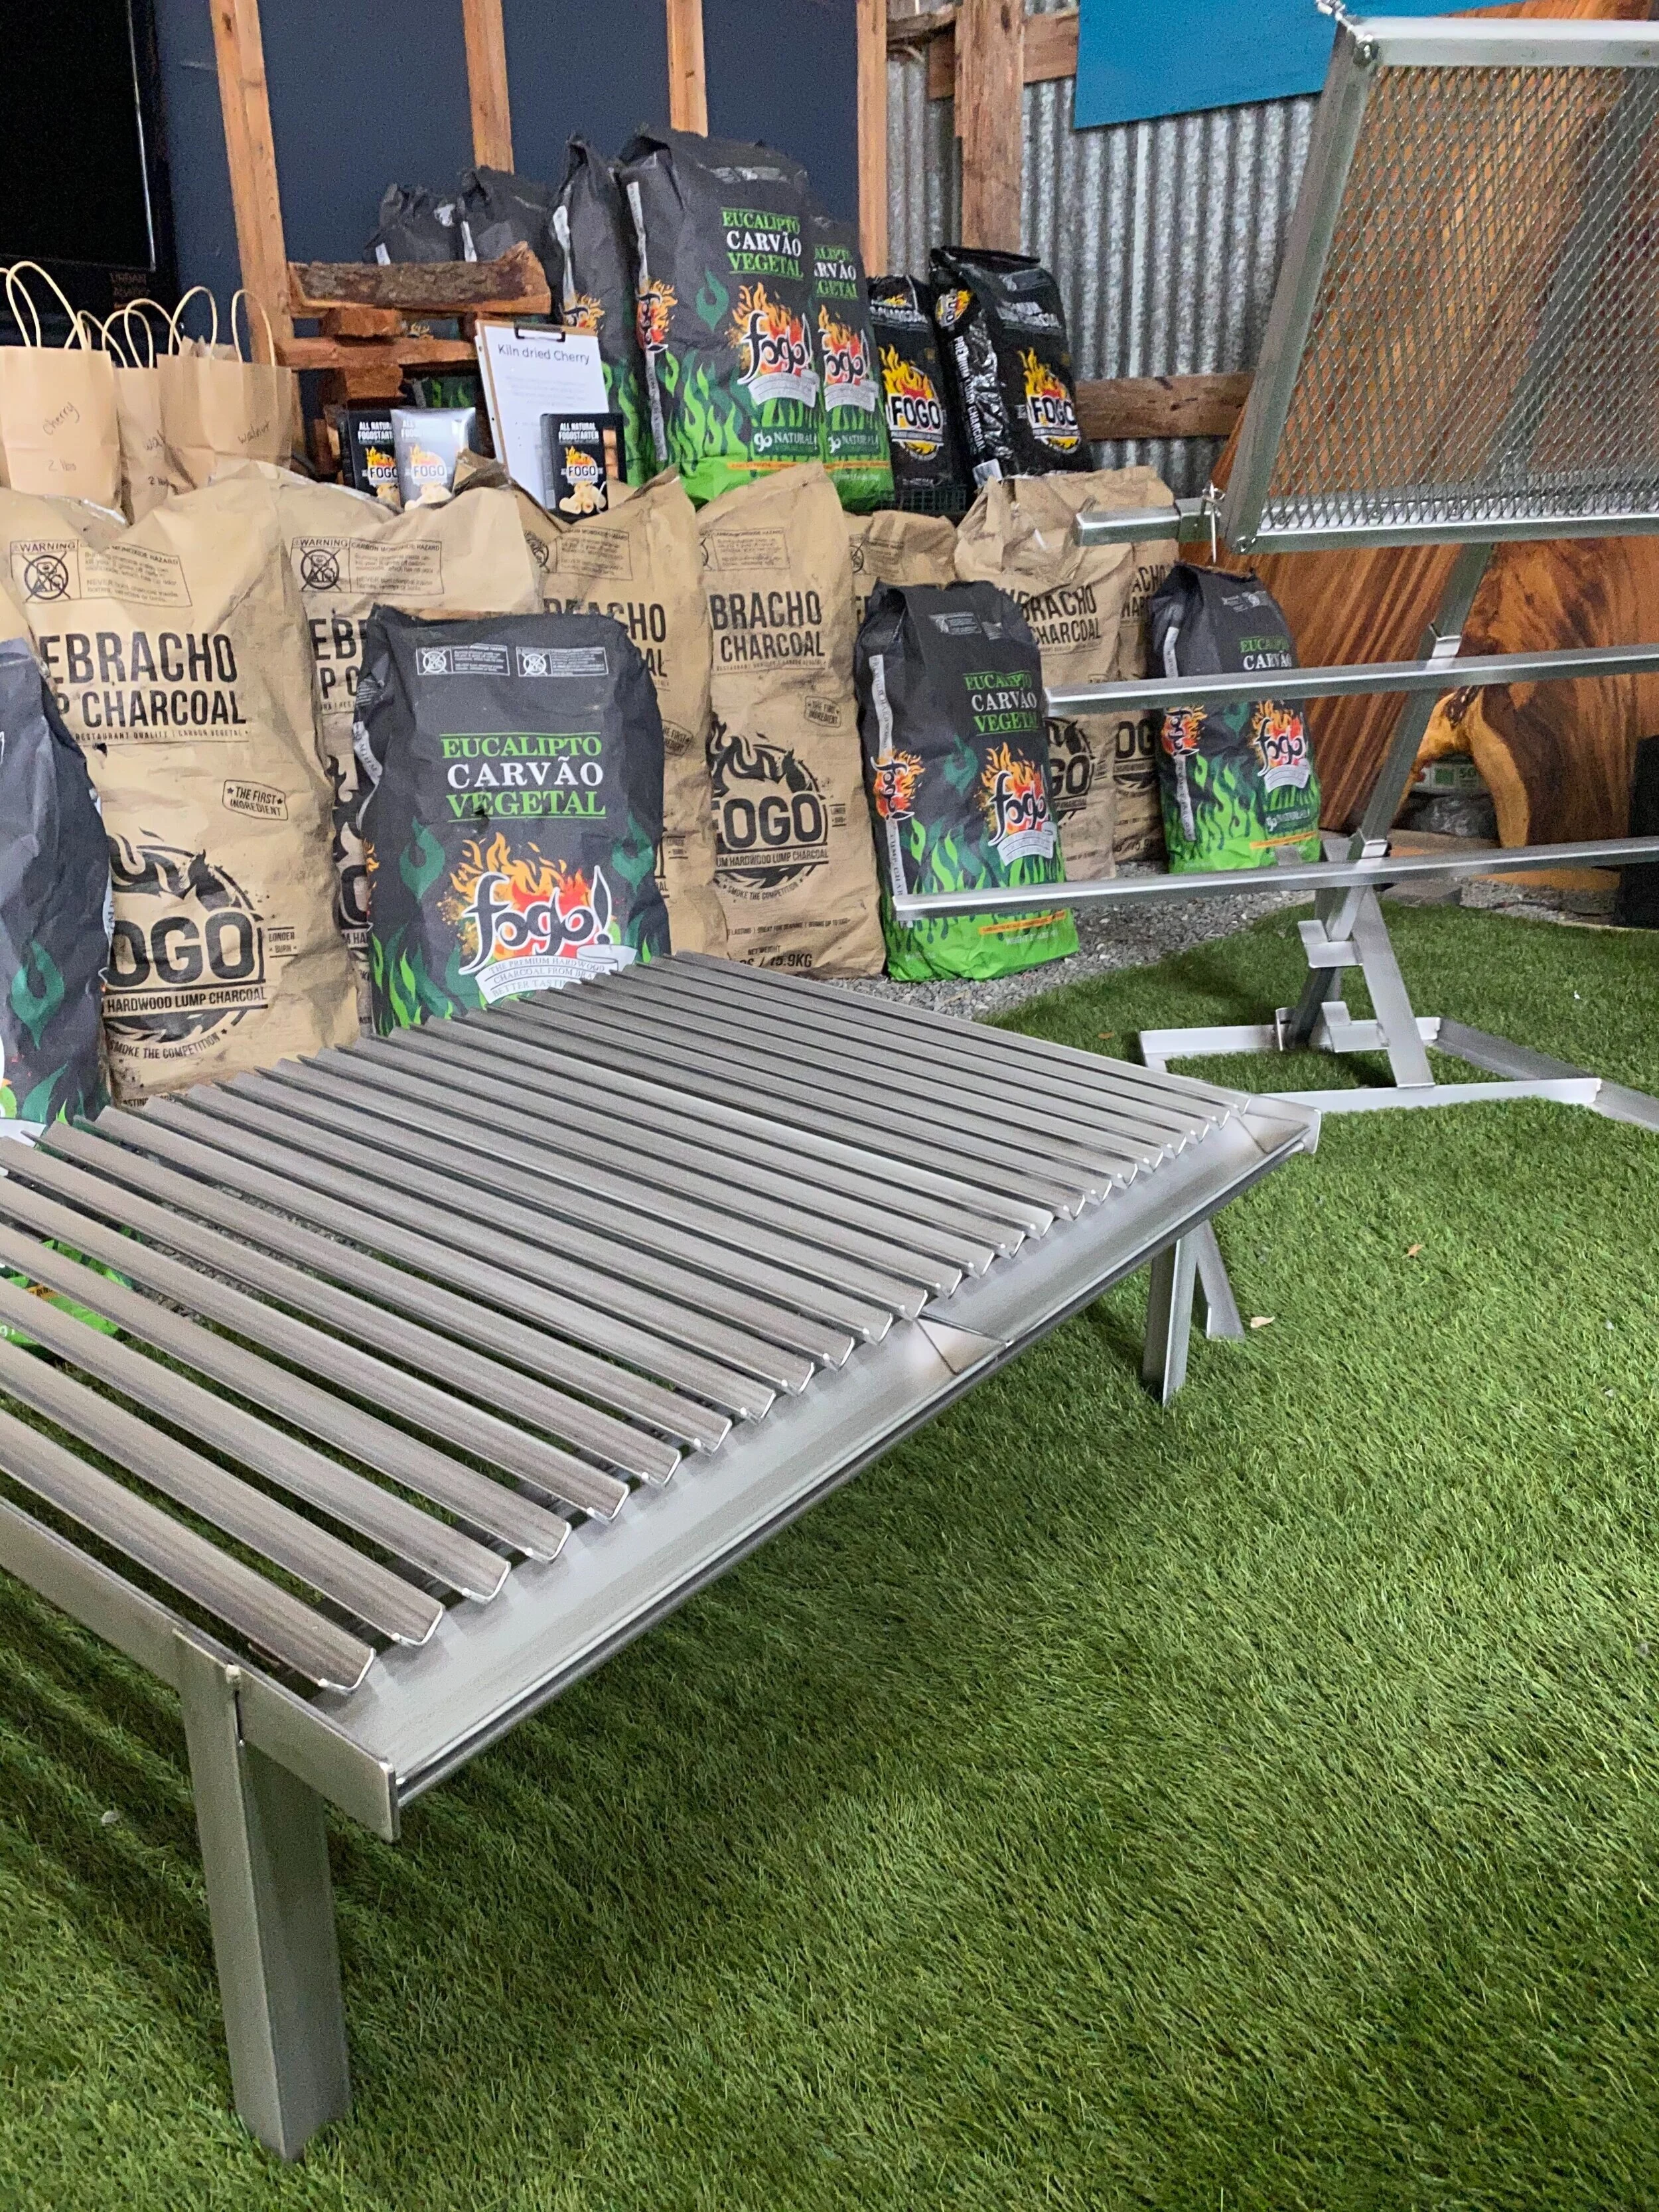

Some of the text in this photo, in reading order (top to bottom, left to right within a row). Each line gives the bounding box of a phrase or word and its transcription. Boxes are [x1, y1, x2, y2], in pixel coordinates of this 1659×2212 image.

[727, 230, 802, 258] CARVÃO
[727, 252, 804, 278] VEGETAL
[498, 344, 590, 365] Kiln dried Cherry
[891, 396, 942, 429] FOGO
[414, 465, 445, 477] FOGO
[569, 466, 596, 477] FOGO
[19, 542, 76, 553] WARNING
[300, 538, 348, 548] WARNING
[709, 591, 822, 630] BRACHO
[38, 631, 238, 684] EBRACHO
[721, 631, 825, 663] CHARCOAL
[83, 689, 246, 728] CHARCOAL
[441, 736, 603, 759] EUCALIPTO
[447, 756, 604, 790] CARVÃO
[236, 786, 277, 804] THE FIRST
[446, 790, 607, 818] VEGETAL
[730, 855, 771, 866] HARDWOOD
[773, 853, 791, 863] LUMP
[793, 849, 828, 861] CHARCOAL
[489, 957, 605, 974] THE PREMIUM HARDWOOD
[493, 967, 544, 984] CHARCOAL
[107, 986, 267, 1013] HARDWOOD LUMP CHARCOAL
[493, 980, 530, 996] BETTER
[109, 1033, 222, 1060] SMOKE THE COMPETITION
